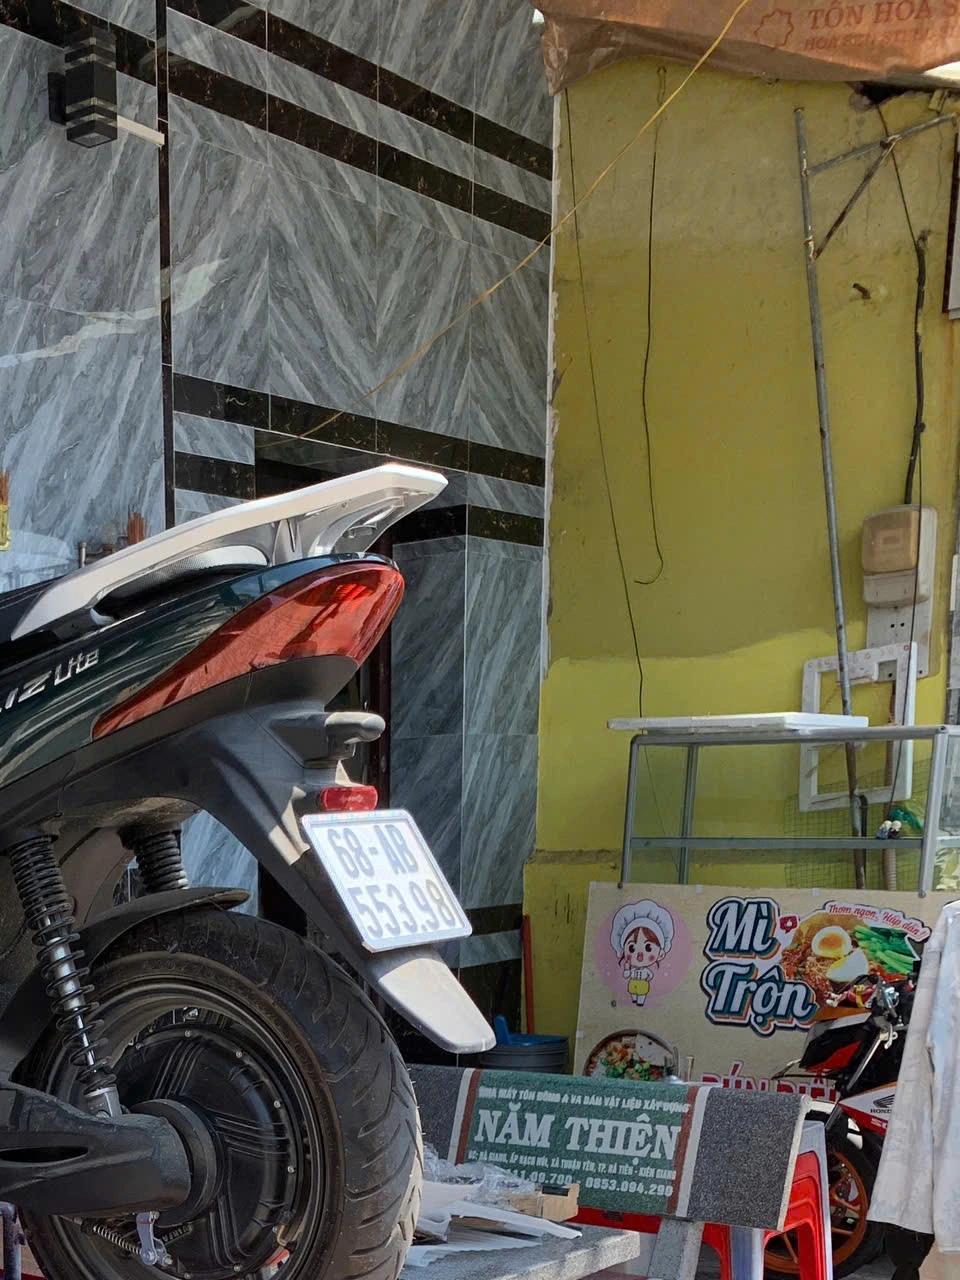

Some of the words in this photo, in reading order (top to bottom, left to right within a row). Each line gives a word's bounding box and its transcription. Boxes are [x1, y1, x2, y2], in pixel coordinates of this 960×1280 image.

[808, 0, 865, 30] TÔN
[874, 0, 931, 24] HOA
[327, 824, 418, 878] 68-AB
[348, 879, 456, 938] 553.98
[709, 899, 775, 953] Mì
[705, 963, 815, 1024] Trộn
[474, 1101, 556, 1149] NĂM
[564, 1112, 682, 1166] THIỆN
